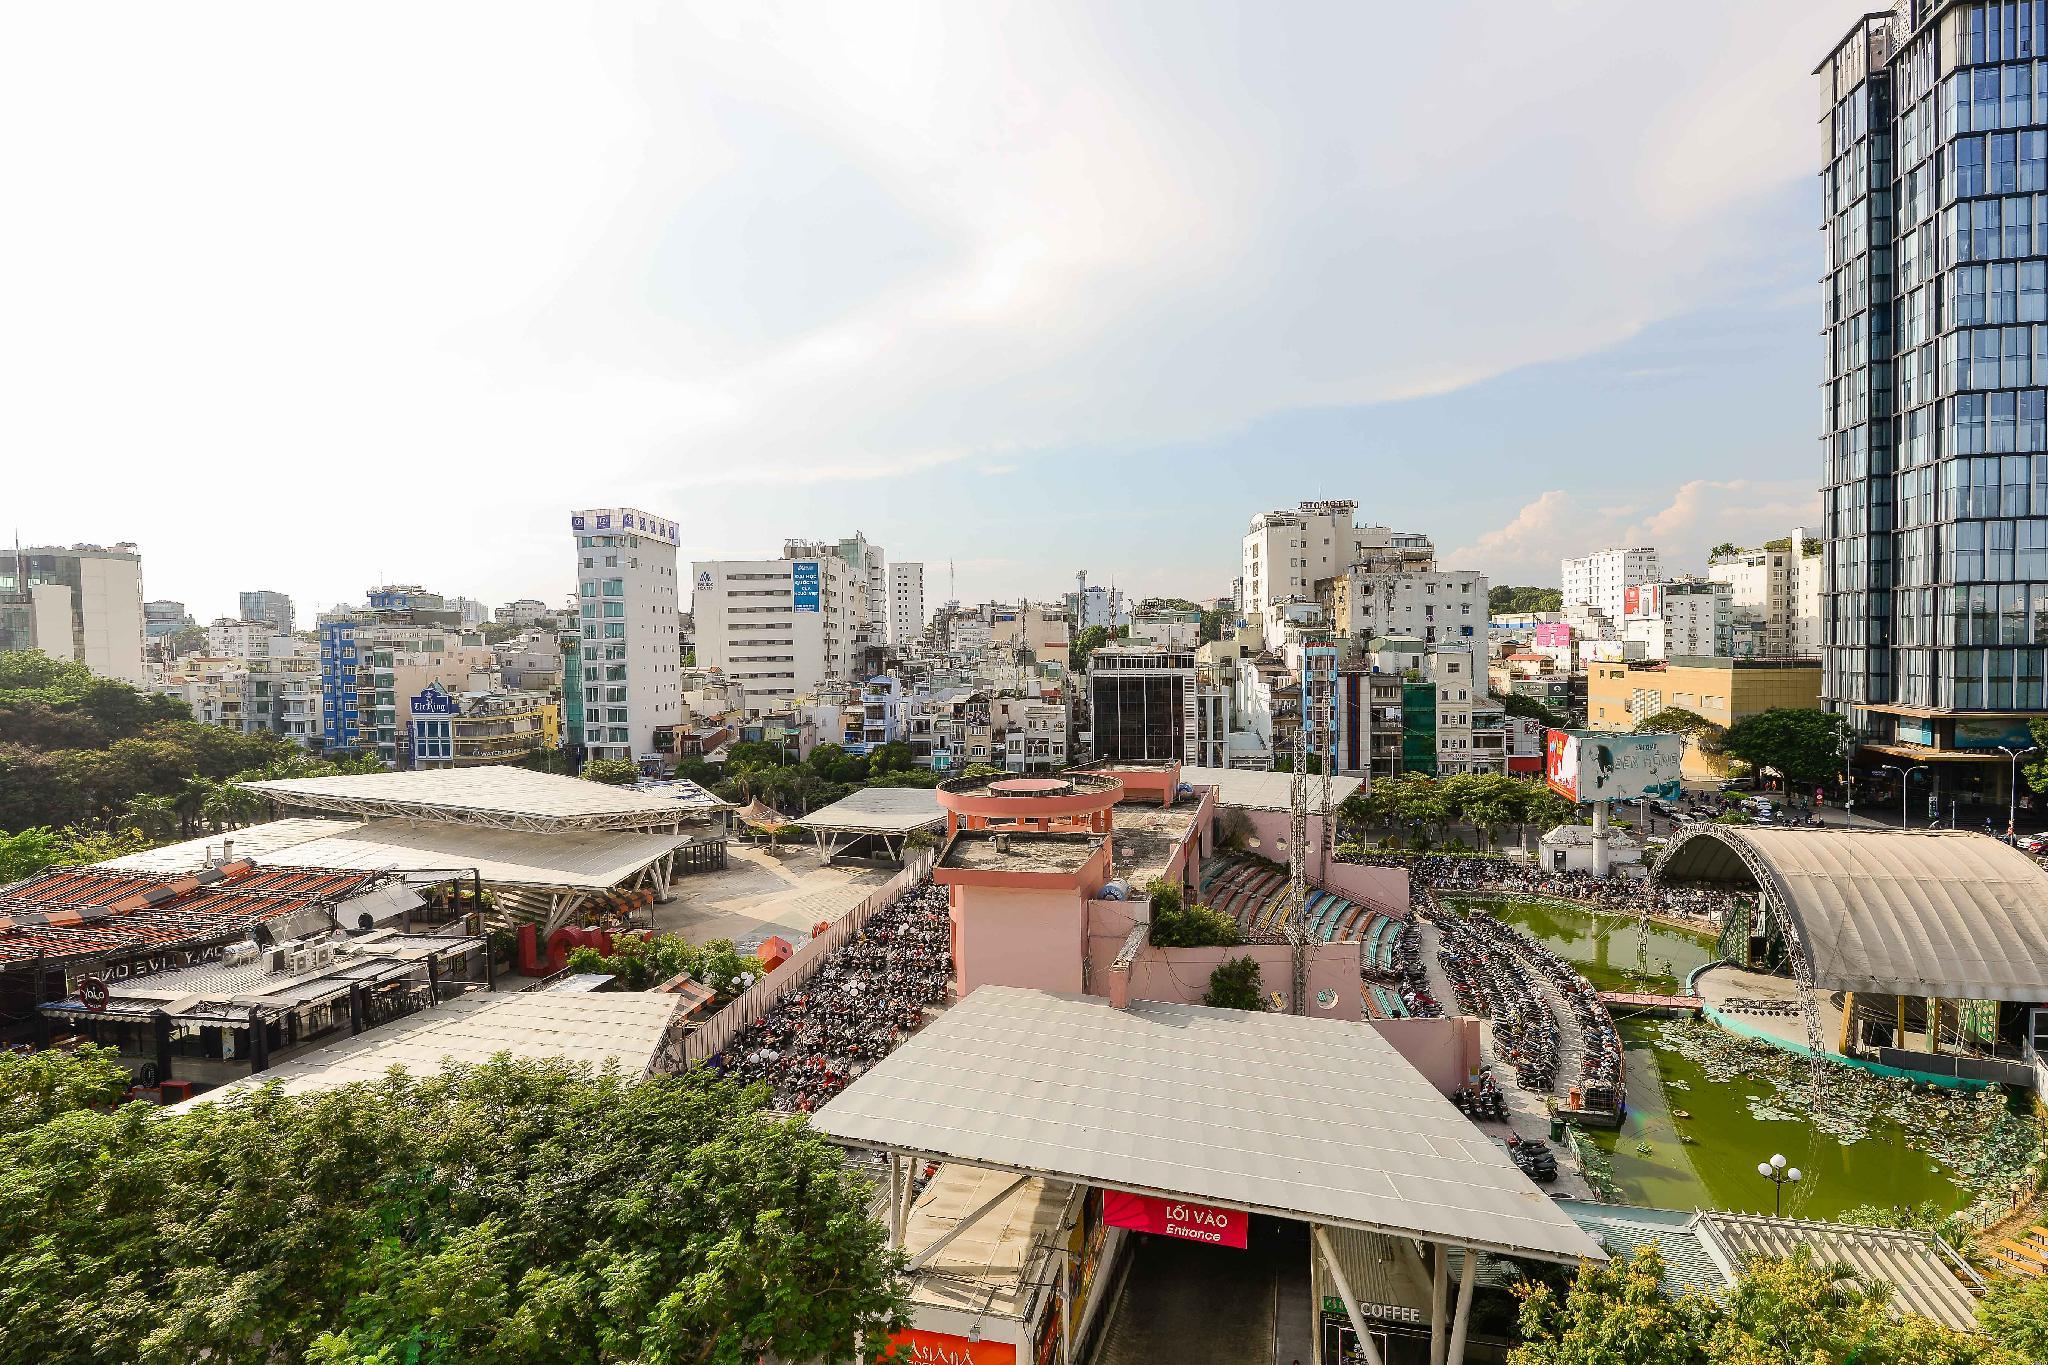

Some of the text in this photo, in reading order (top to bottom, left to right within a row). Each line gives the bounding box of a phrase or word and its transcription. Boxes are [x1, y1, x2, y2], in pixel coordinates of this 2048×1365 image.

[1166, 1204, 1229, 1228] LỐI VÀO
[1166, 1223, 1221, 1242] Entrance
[1360, 1302, 1420, 1323] COFFEE
